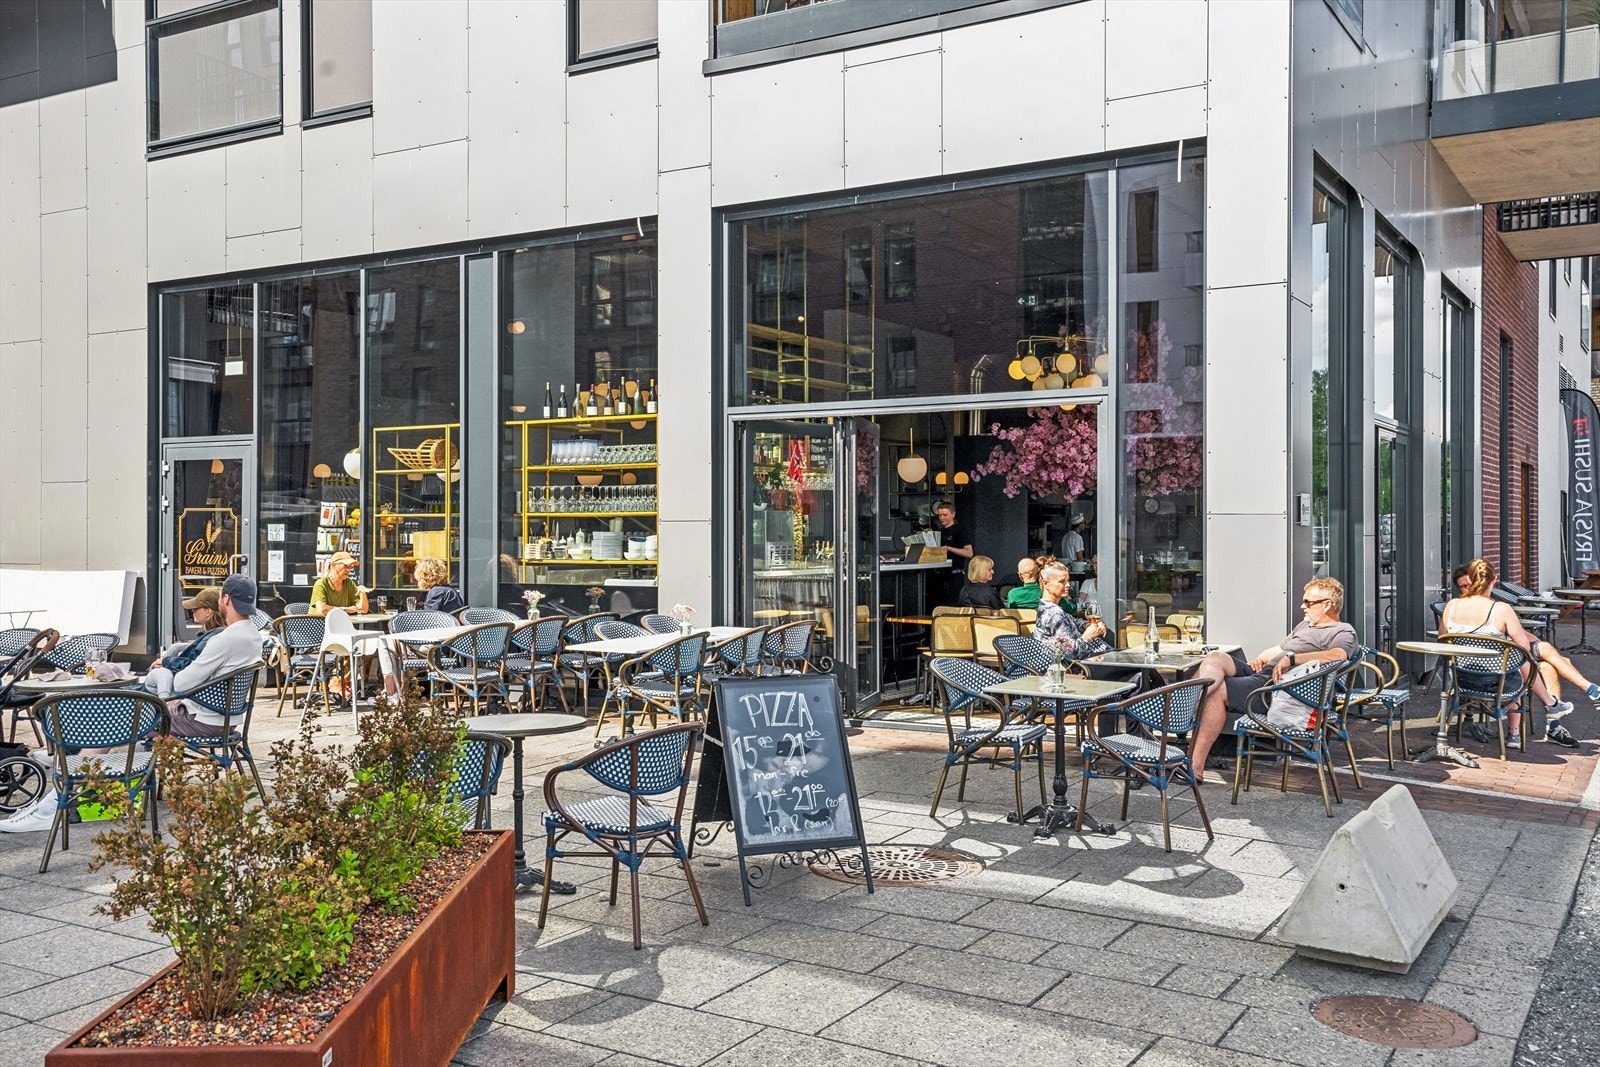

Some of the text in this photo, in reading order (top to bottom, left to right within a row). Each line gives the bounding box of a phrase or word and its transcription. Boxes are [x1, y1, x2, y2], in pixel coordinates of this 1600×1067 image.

[184, 538, 229, 566] Grains
[185, 566, 202, 575] BAKERI
[207, 567, 229, 576] PIZZERIA
[739, 691, 814, 728] PIZZA
[753, 771, 778, 782] man
[789, 766, 809, 778] fre
[790, 814, 801, 832] &
